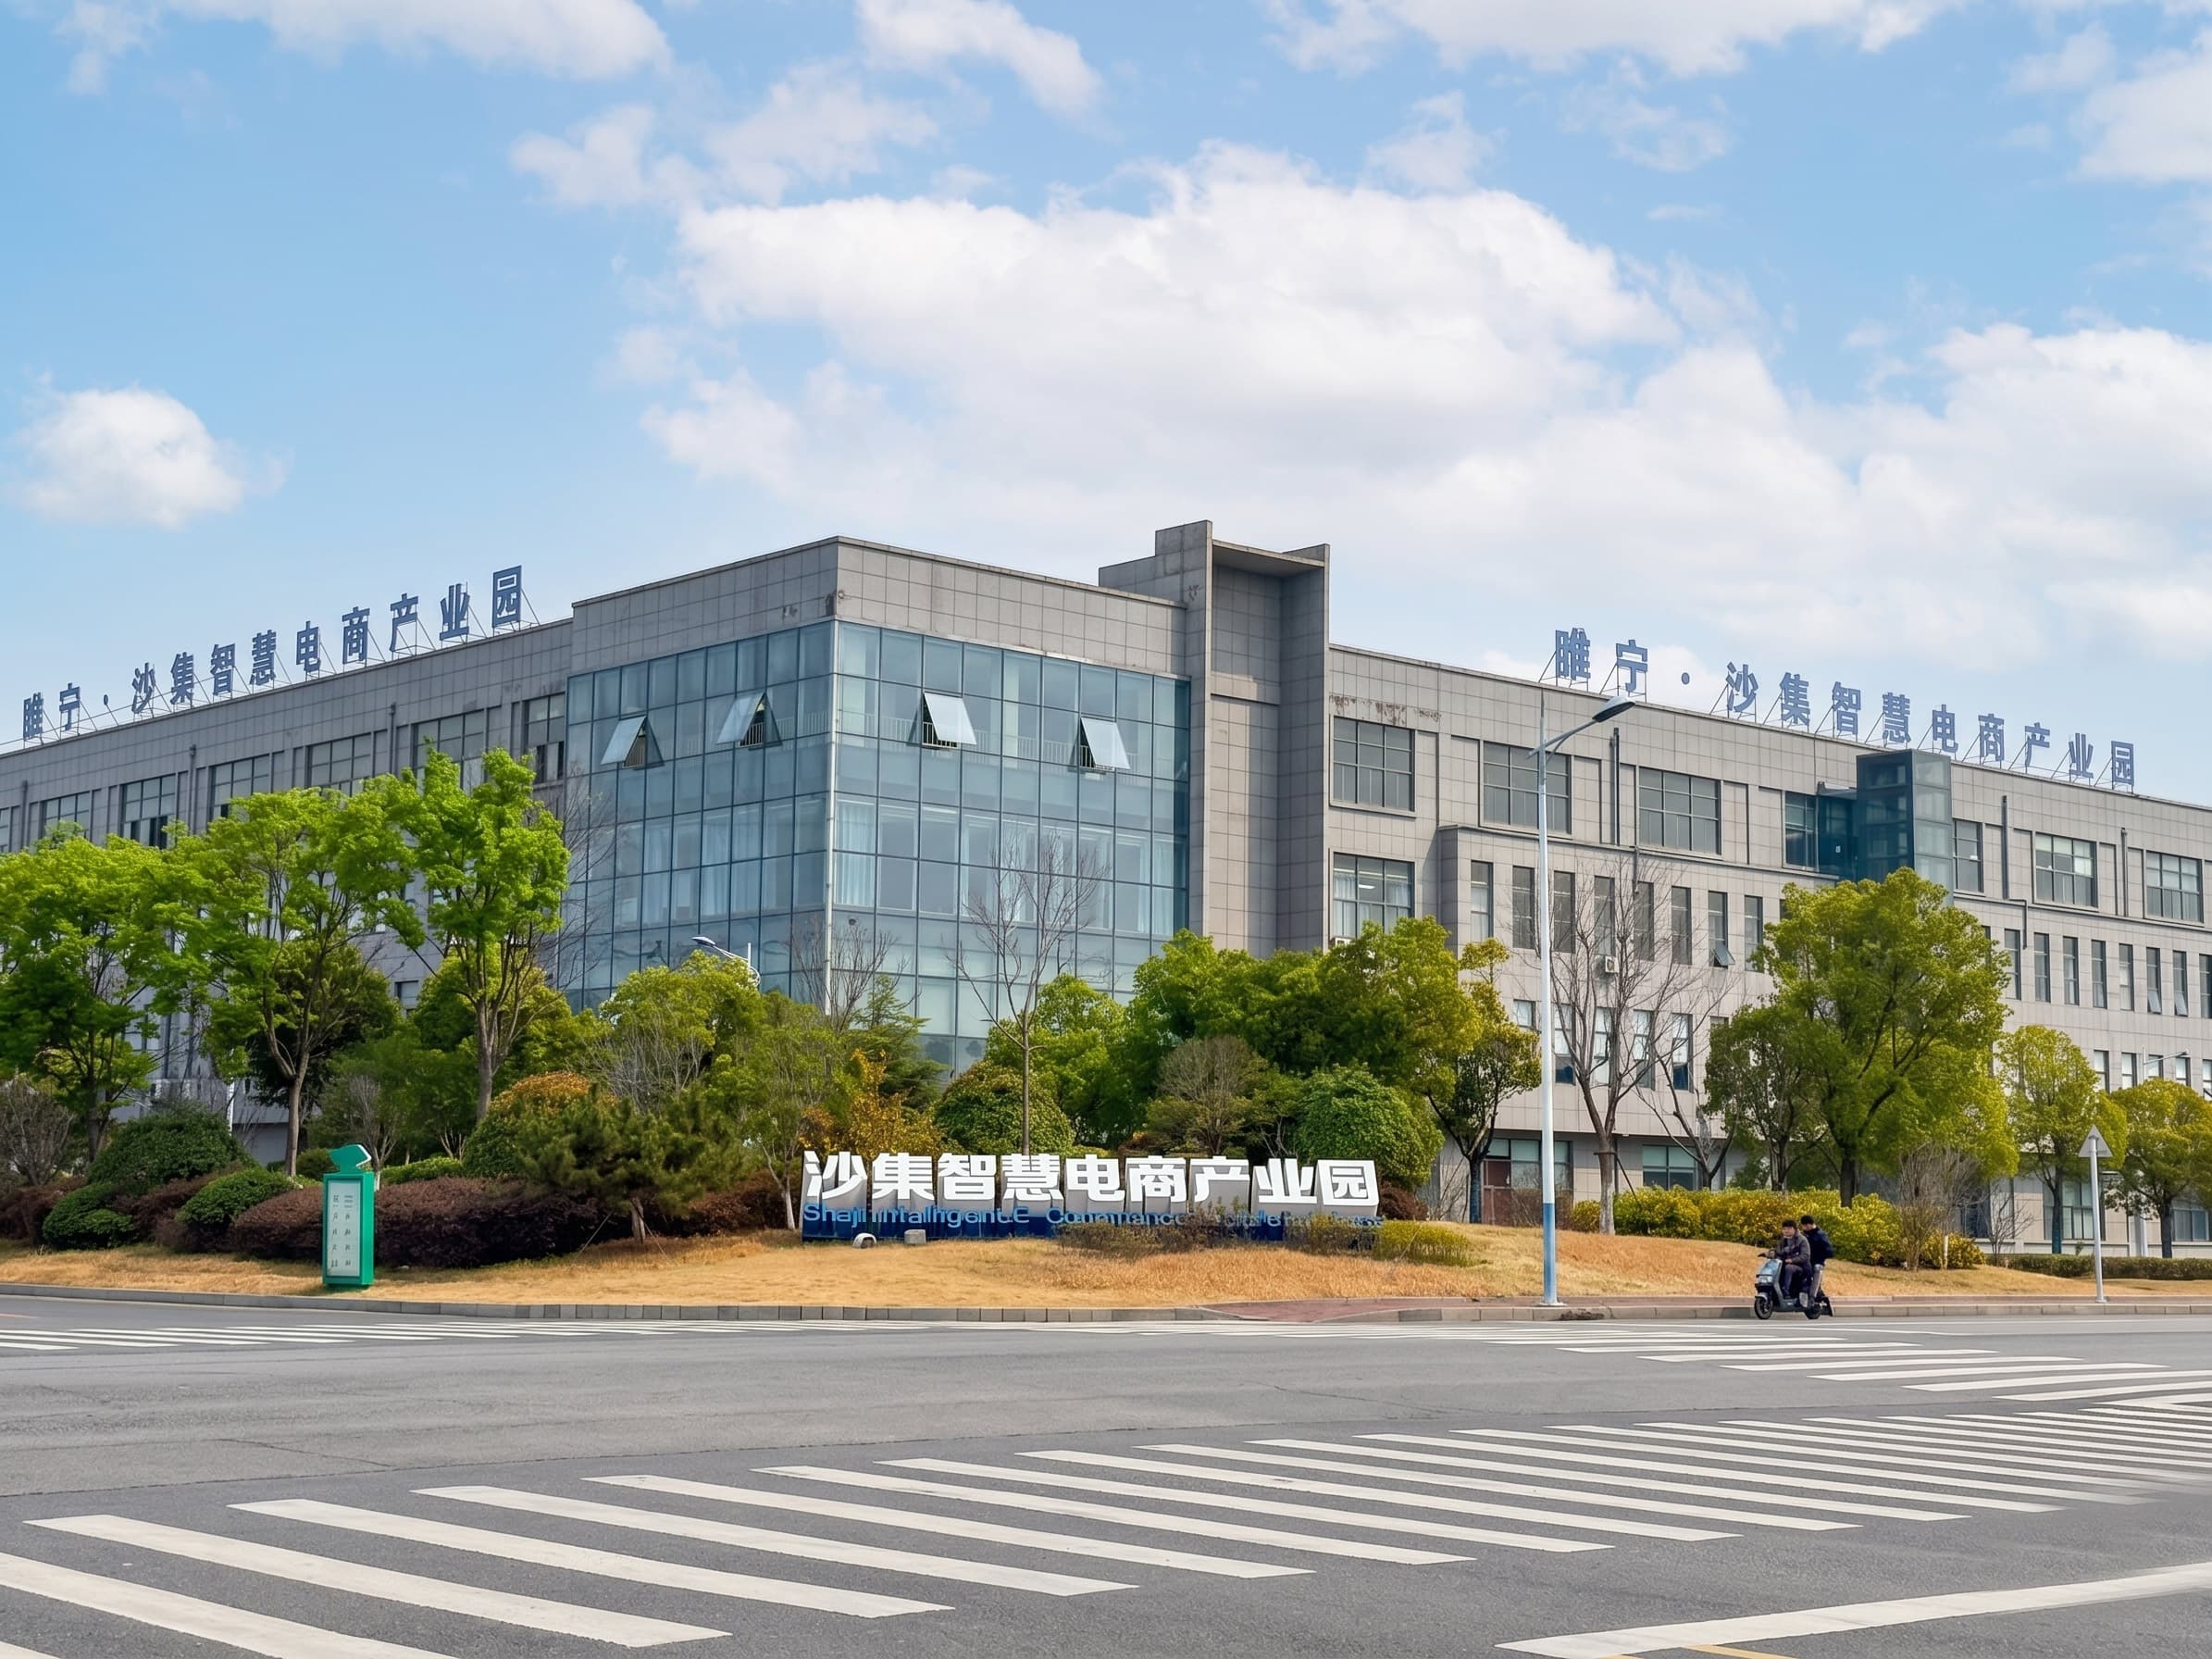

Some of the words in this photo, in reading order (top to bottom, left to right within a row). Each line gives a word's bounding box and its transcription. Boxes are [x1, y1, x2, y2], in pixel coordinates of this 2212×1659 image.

[22, 565, 522, 740] 睢宁·沙集智慧电商产业园
[1555, 627, 2135, 786] 睢宁·沙集智慧电商产业园
[803, 1150, 1379, 1206] 沙集智慧电商产业园
[803, 1204, 867, 1228] Shaji
